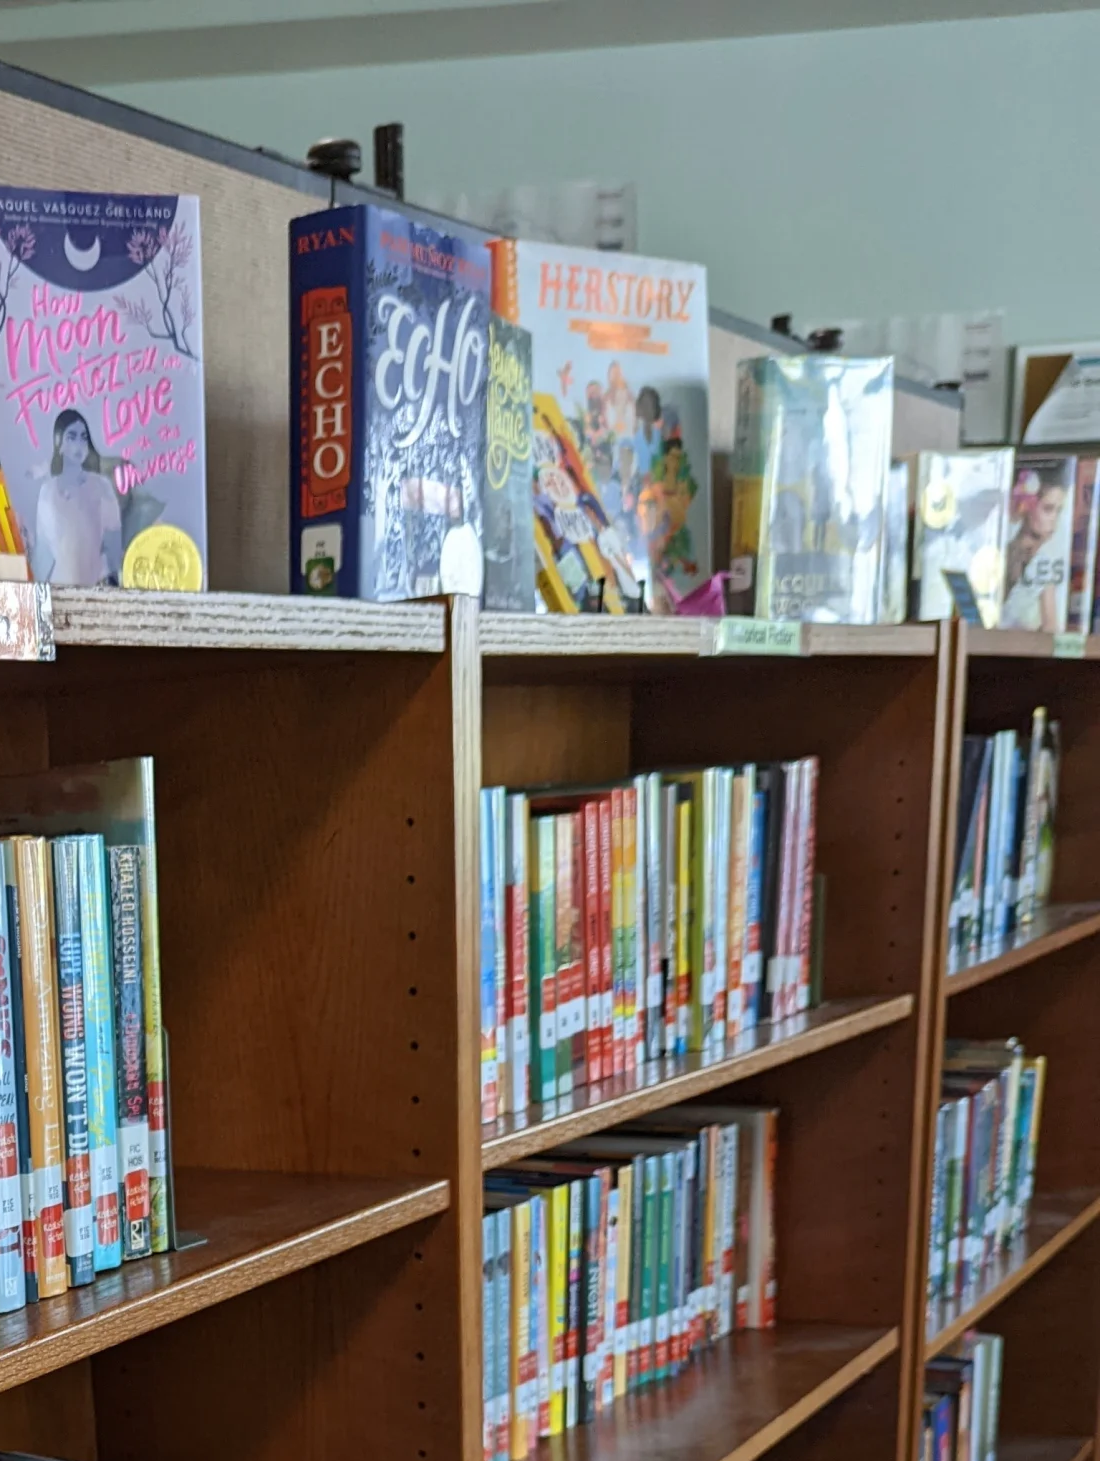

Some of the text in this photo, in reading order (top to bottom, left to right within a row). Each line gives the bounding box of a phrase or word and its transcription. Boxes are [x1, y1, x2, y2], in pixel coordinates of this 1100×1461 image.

[43, 203, 100, 217] VASQUEZ
[296, 226, 356, 255] RYAN
[33, 283, 84, 320] How
[538, 261, 697, 324] HERSTORY
[6, 304, 128, 382] Moon
[102, 376, 174, 446] Love
[312, 320, 348, 480] ECHO
